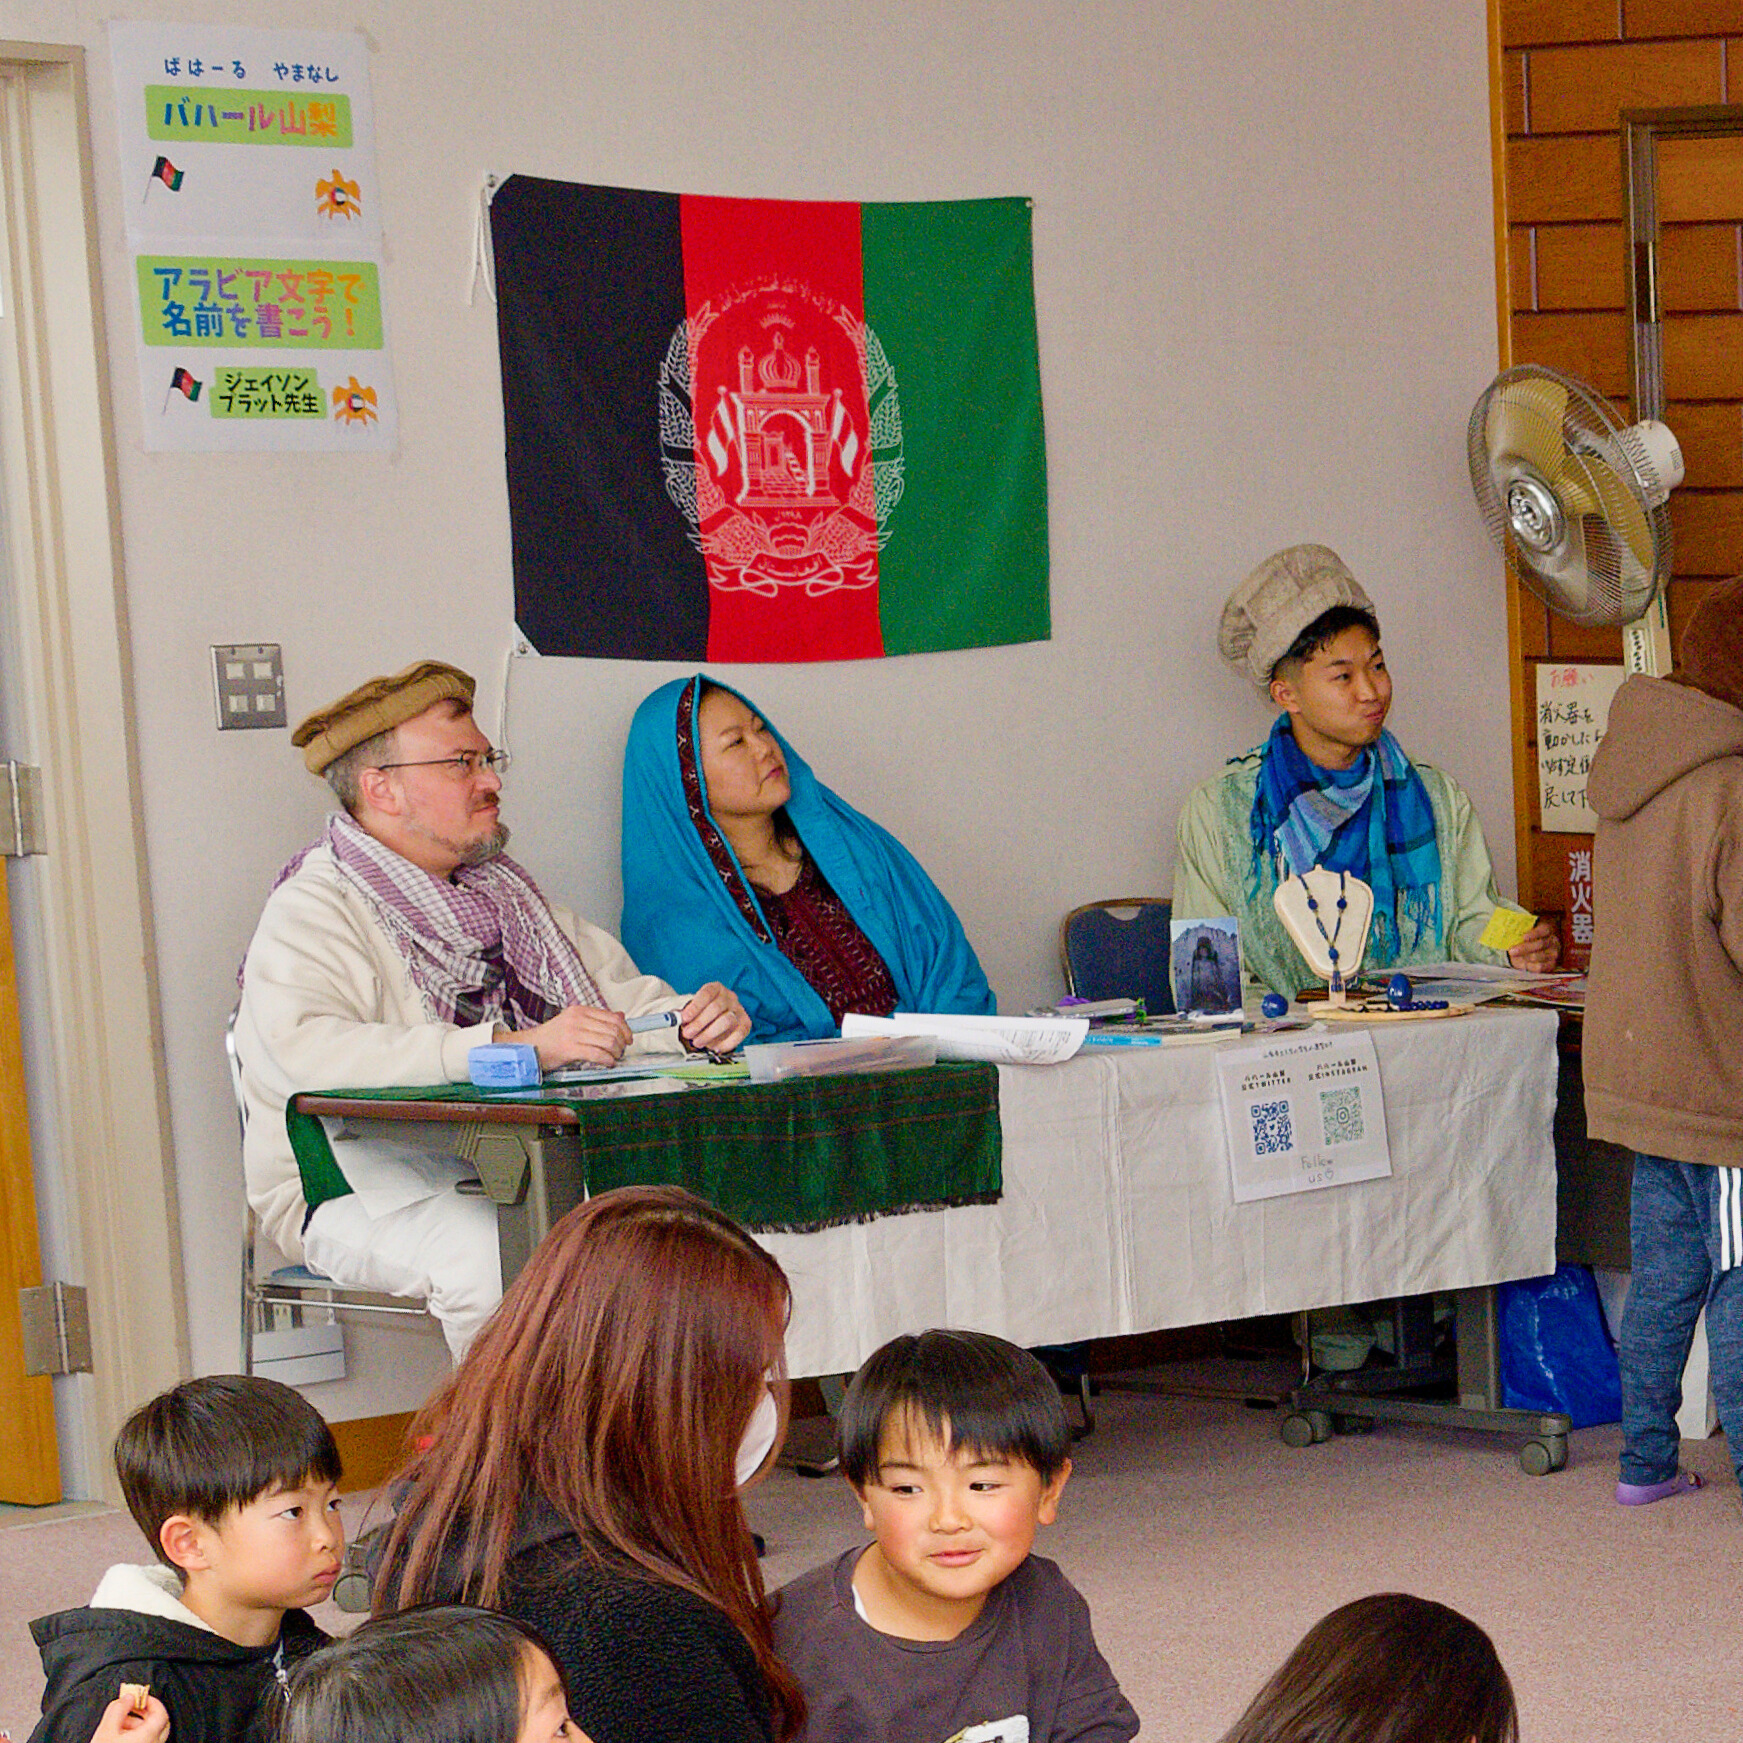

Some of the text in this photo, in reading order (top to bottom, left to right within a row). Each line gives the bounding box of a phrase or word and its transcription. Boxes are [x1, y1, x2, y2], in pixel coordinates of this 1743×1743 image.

[164, 57, 339, 83] ばはーる やまなし
[164, 96, 337, 138] バハール山梨
[153, 267, 367, 304] アラビア文字で
[225, 371, 308, 392] ジェイソン
[1569, 850, 1594, 944] 消火器
